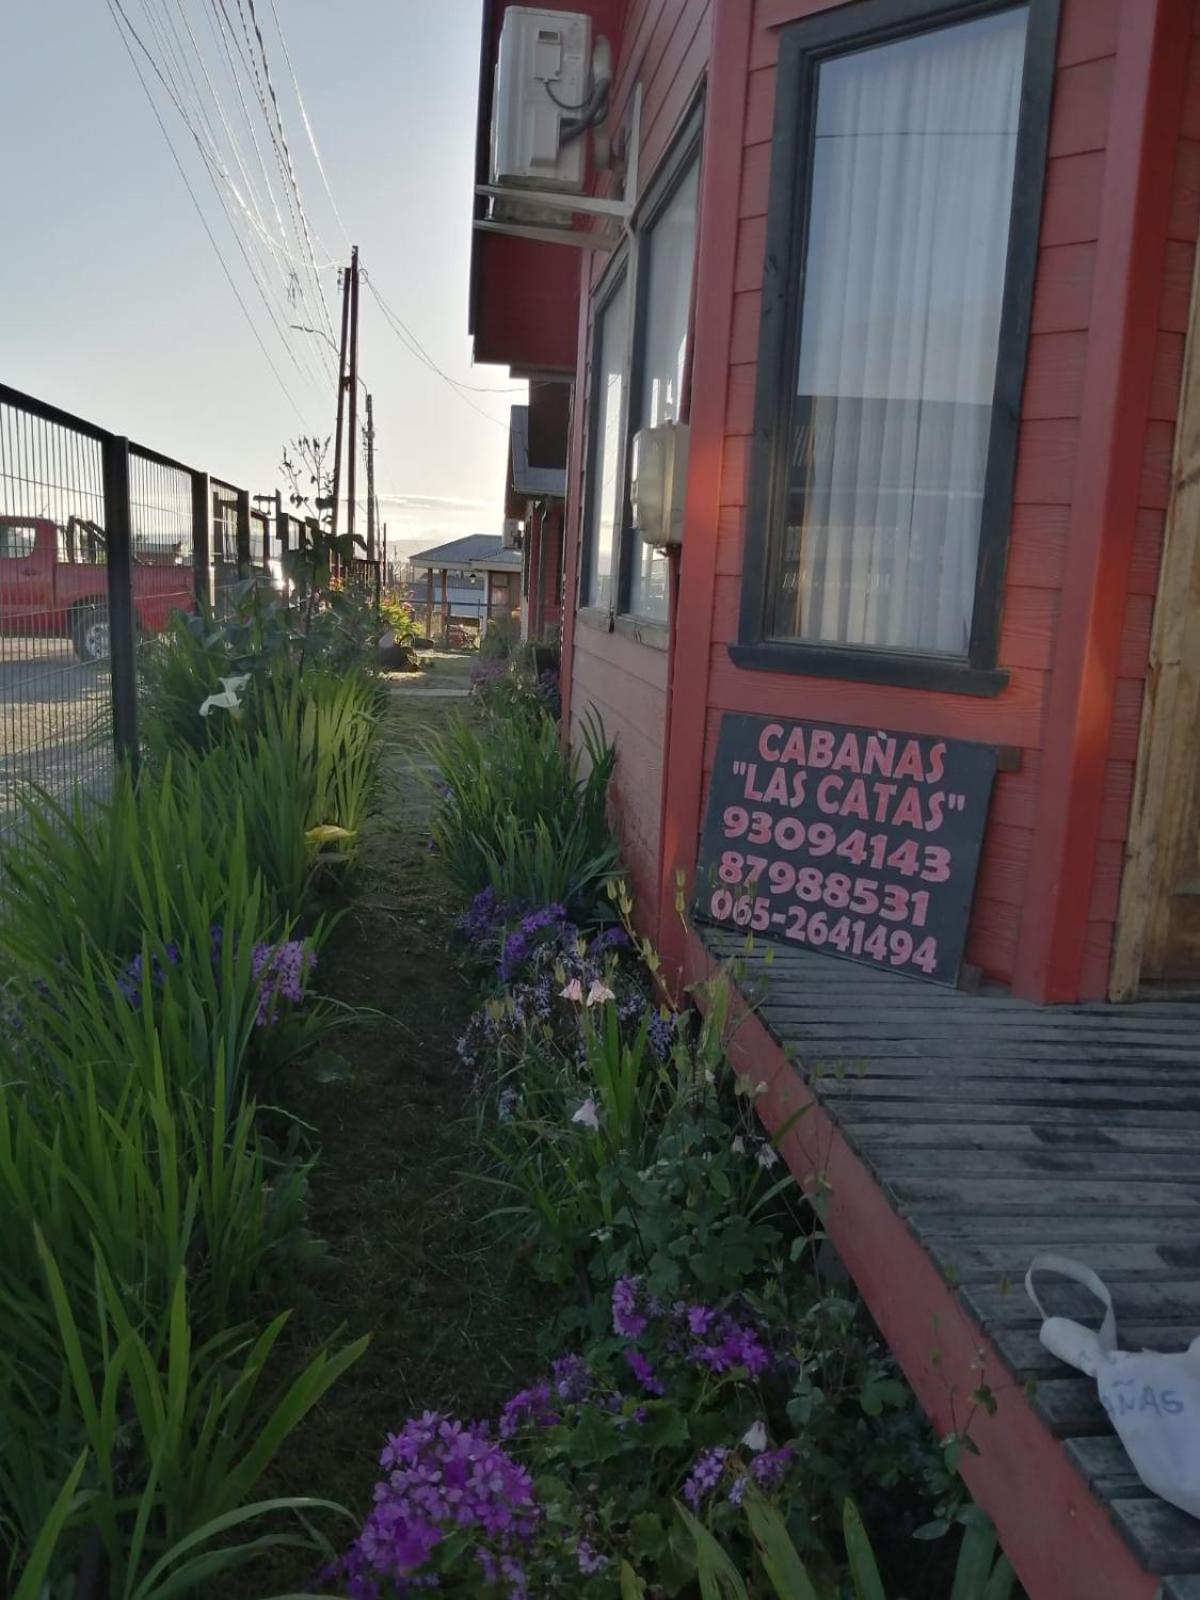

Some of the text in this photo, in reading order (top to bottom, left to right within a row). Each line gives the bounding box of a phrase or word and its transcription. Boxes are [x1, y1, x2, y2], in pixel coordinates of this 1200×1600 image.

[759, 724, 946, 784] CABAÑAS
[733, 761, 965, 832] "LAS CATAS"
[723, 806, 951, 882] 93094143
[719, 851, 930, 927] 87988531
[711, 889, 937, 973] 065-2641494
